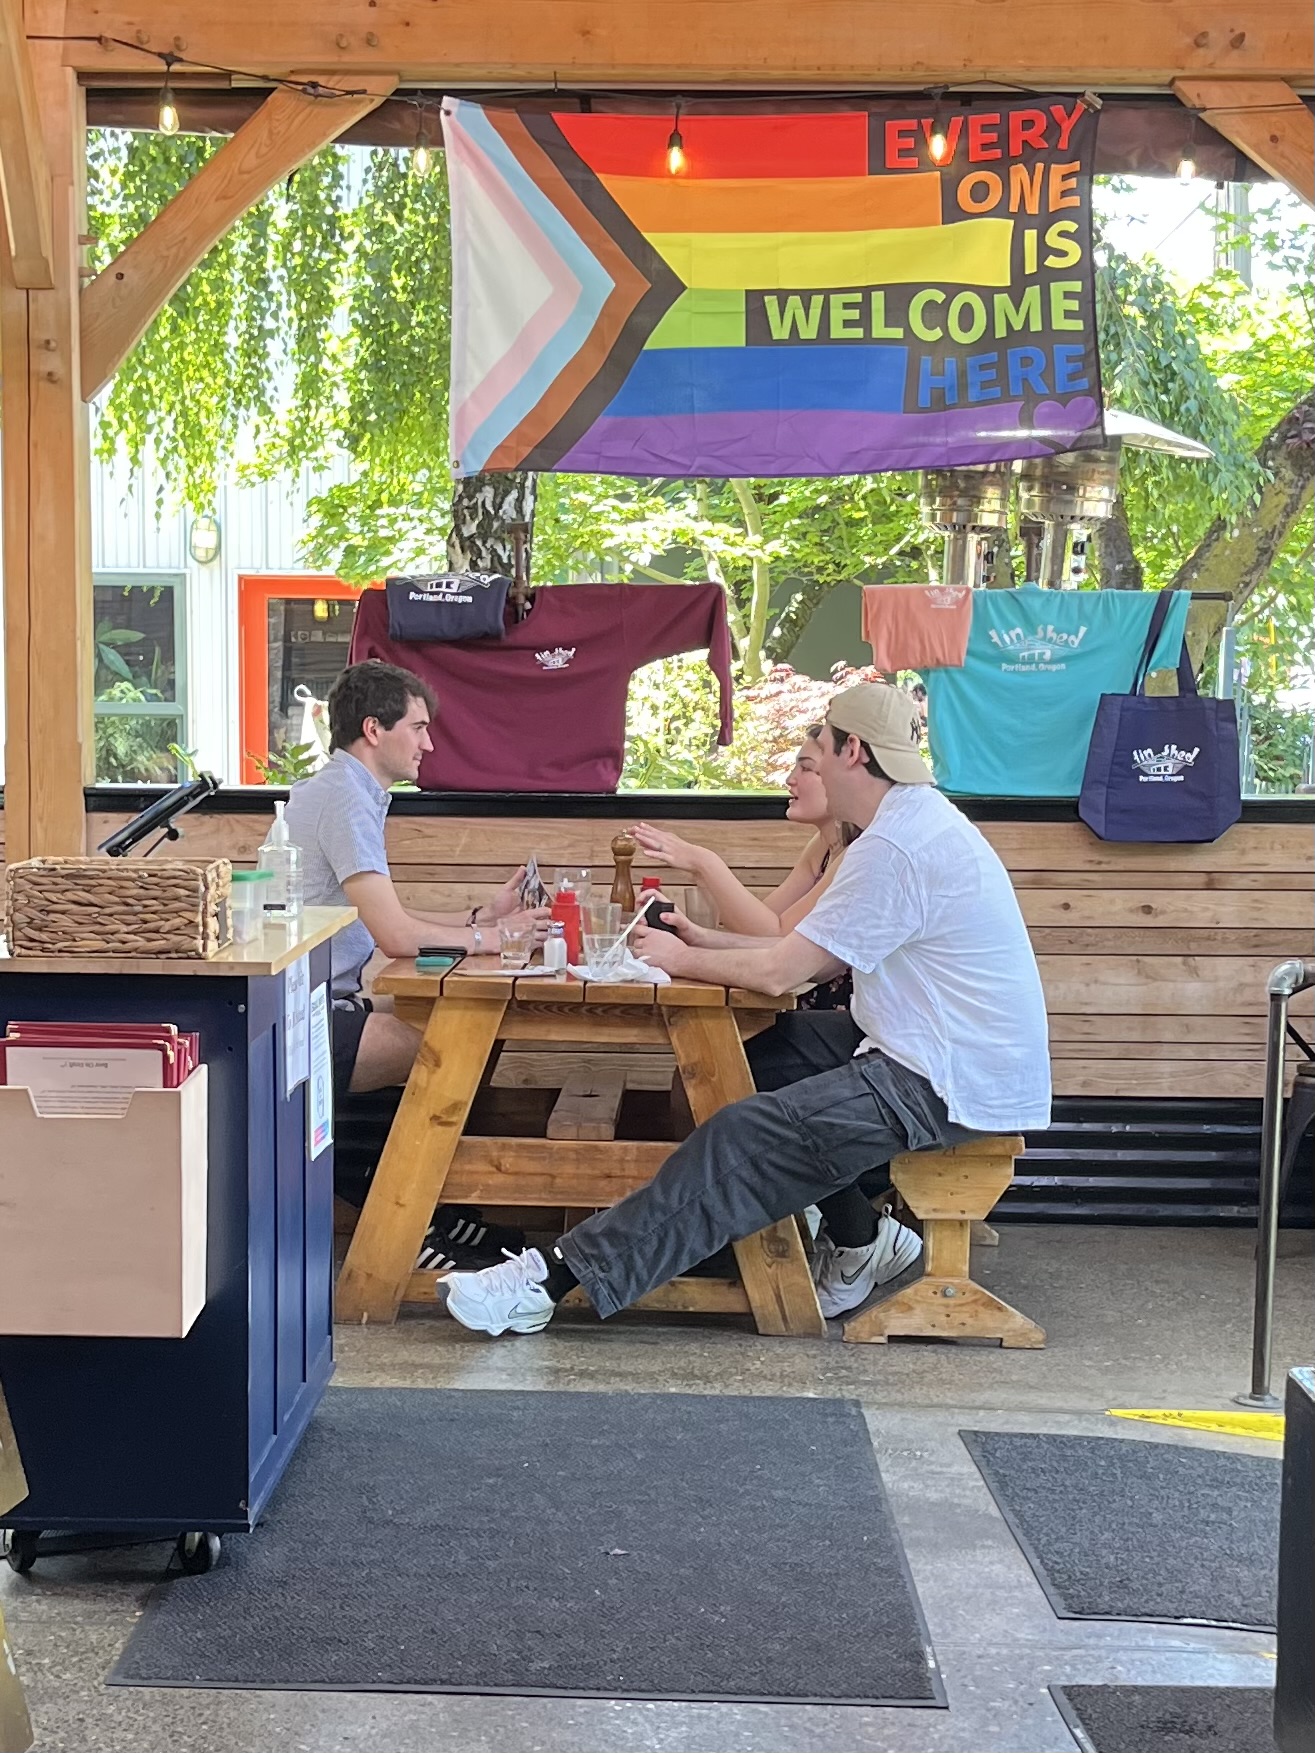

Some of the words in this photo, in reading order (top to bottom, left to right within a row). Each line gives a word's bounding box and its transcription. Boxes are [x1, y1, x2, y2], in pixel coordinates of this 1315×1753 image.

[884, 103, 1085, 169] EVERY
[956, 160, 1081, 215] ONE
[1023, 220, 1082, 274] IS
[763, 281, 1085, 344] WELCOME
[917, 344, 1089, 408] HERE
[445, 593, 473, 603] Oregon
[1038, 663, 1067, 672] Oregon
